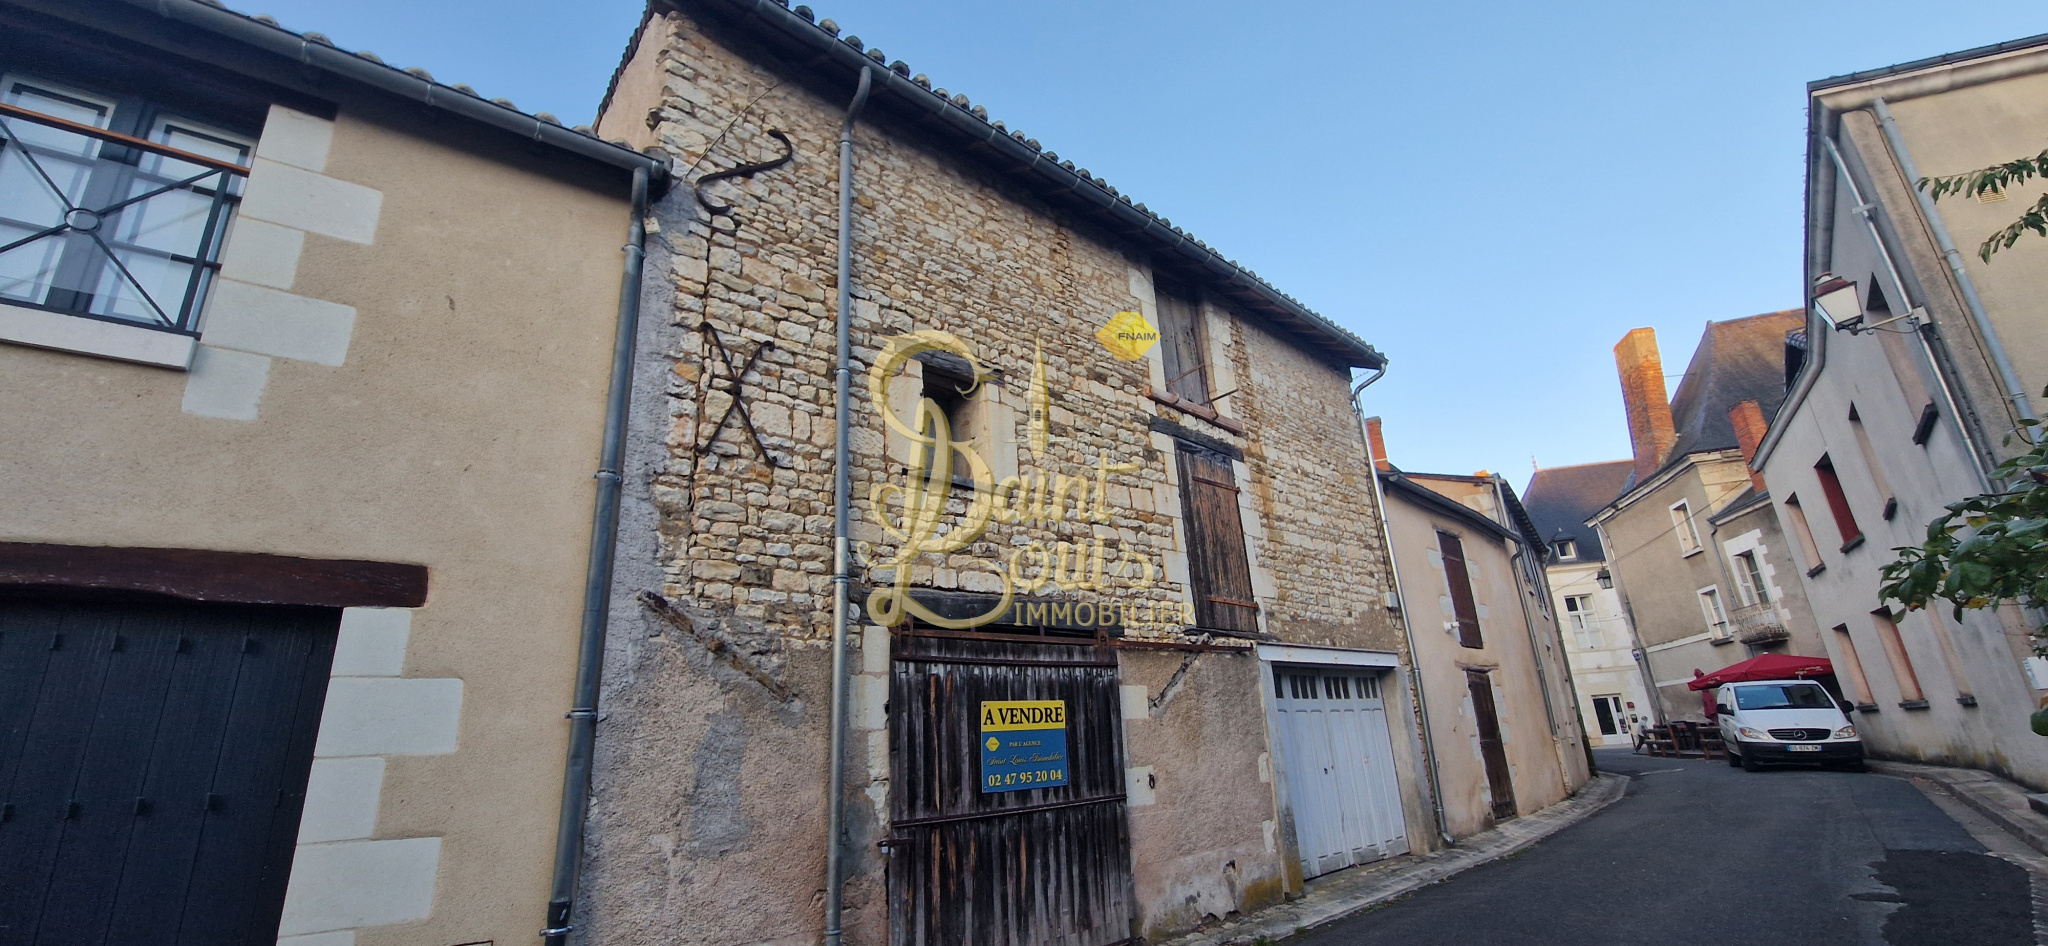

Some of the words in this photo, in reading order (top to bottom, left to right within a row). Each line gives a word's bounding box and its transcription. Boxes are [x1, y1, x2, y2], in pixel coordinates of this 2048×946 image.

[983, 709, 995, 725] A
[998, 707, 1064, 725] VENDRE
[988, 774, 1001, 787] 02
[1004, 773, 1017, 785] 47
[1020, 771, 1032, 784] 95
[1035, 770, 1047, 782] 20
[1050, 769, 1062, 780] 04
